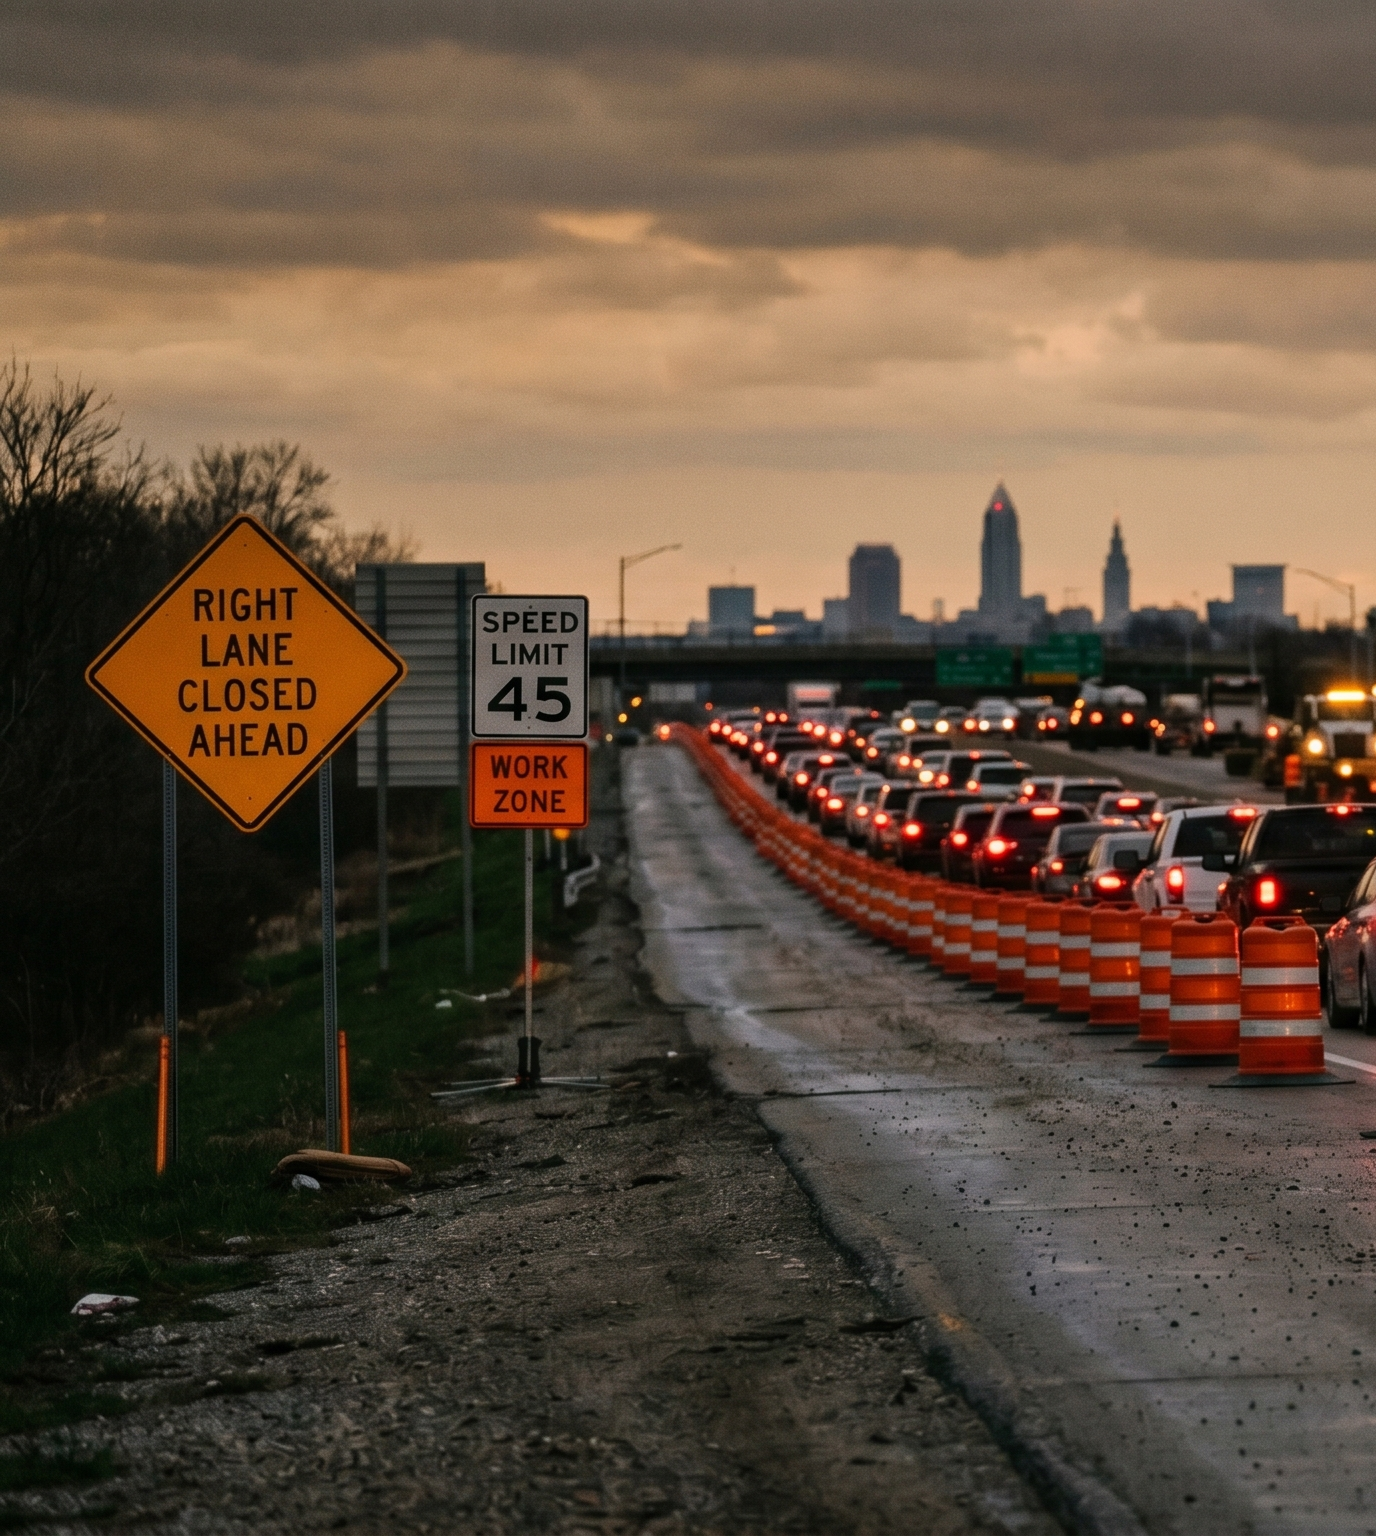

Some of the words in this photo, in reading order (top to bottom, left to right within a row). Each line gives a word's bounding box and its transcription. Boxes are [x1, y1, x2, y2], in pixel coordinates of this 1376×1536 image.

[193, 587, 299, 622] RIGHT
[482, 611, 580, 634] SPEED
[201, 632, 294, 668] LANE
[491, 643, 569, 666] LIMIT
[177, 677, 317, 713] CLOSED
[487, 676, 572, 723] 45
[188, 722, 308, 758] AHEAD
[490, 755, 569, 779] WORK
[493, 789, 567, 814] ZONE
